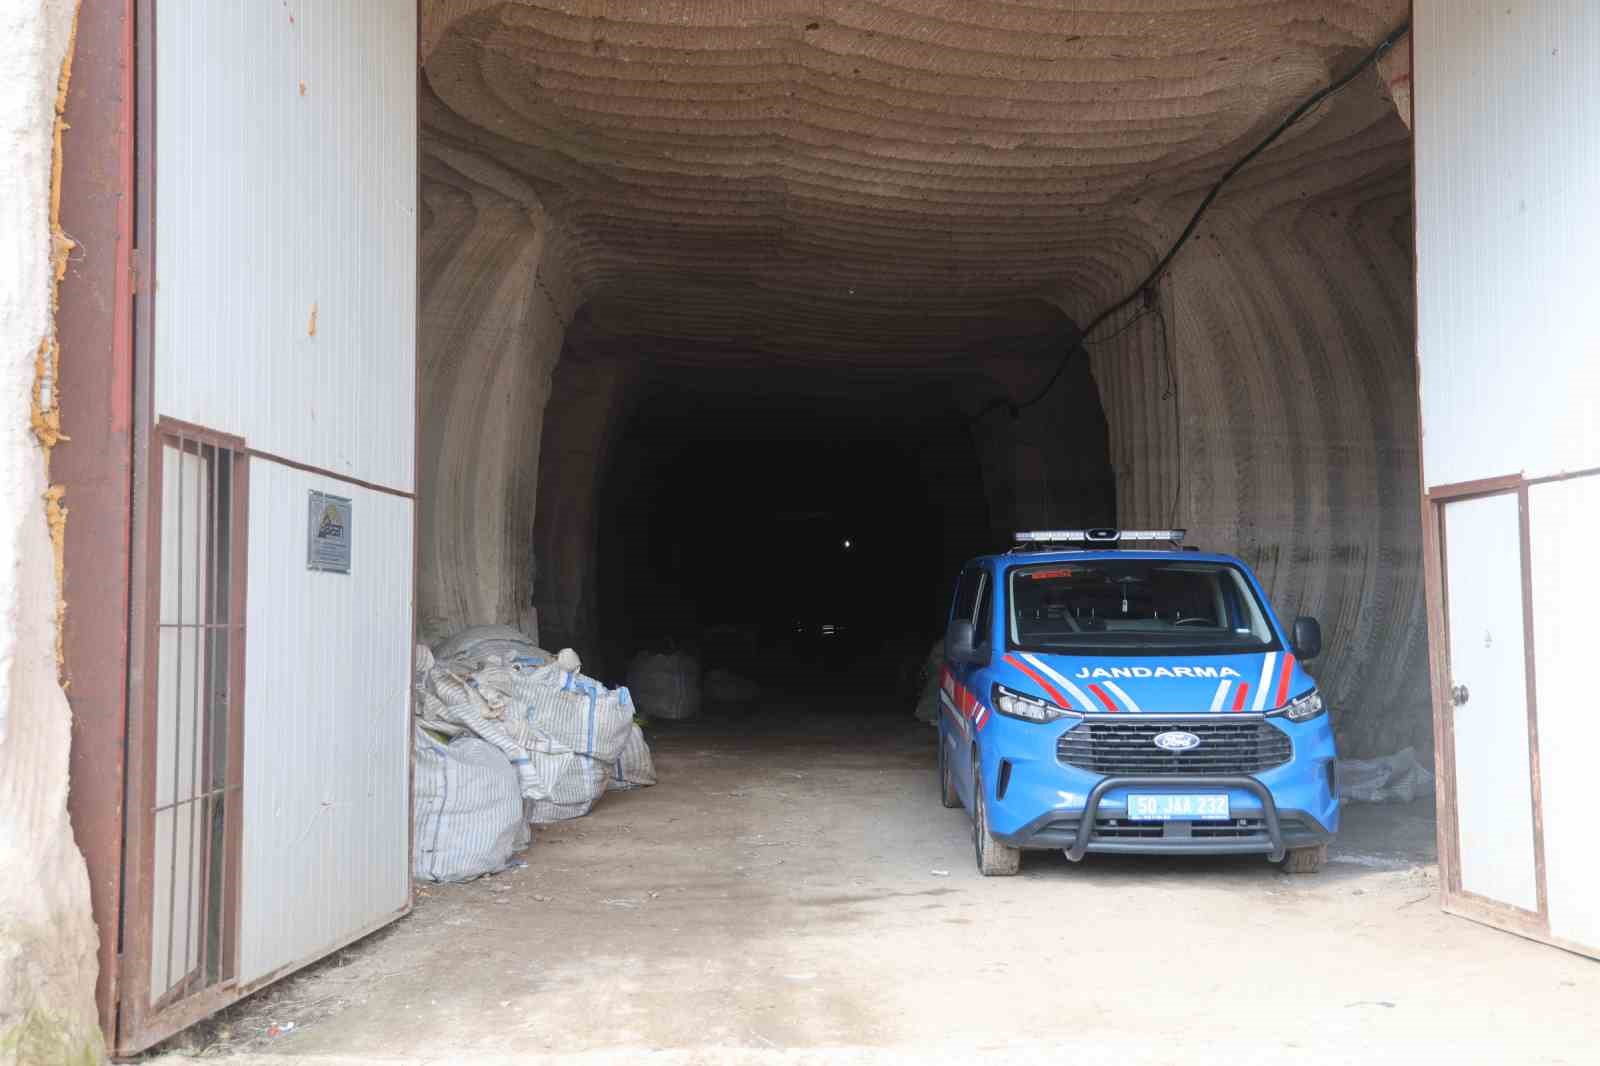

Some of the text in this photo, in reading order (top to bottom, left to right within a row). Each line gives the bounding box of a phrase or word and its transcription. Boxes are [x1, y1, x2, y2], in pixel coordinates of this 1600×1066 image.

[1075, 666, 1241, 679] JANDARMA
[1157, 733, 1191, 747] Ford
[1136, 796, 1226, 815] 50 JAA 232
